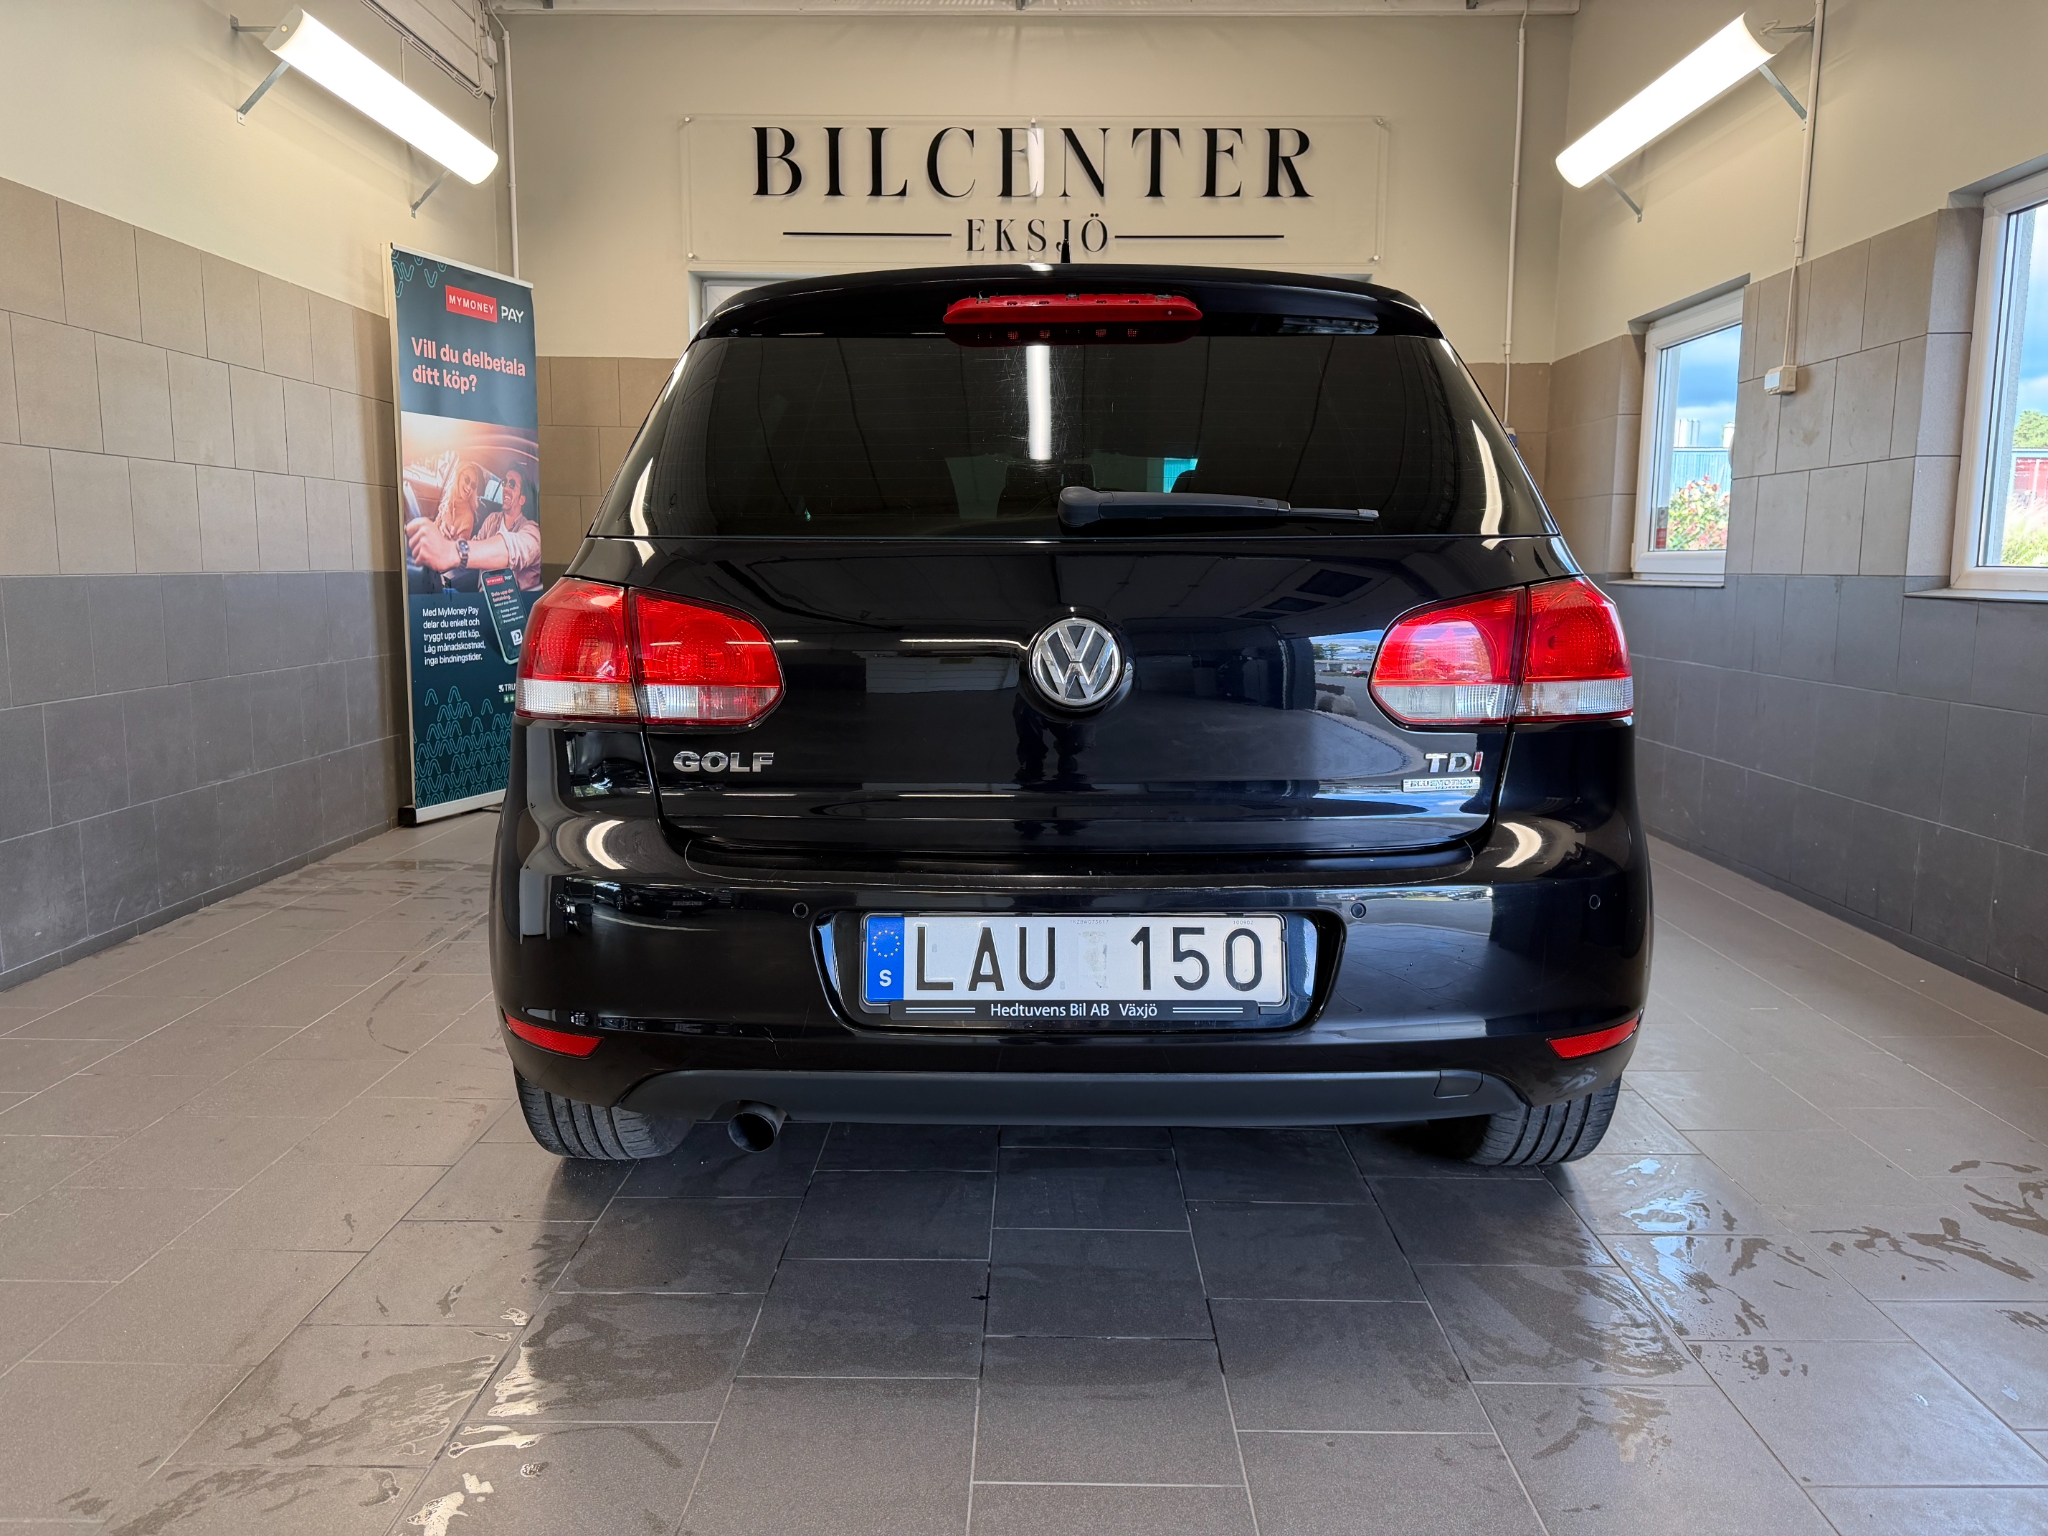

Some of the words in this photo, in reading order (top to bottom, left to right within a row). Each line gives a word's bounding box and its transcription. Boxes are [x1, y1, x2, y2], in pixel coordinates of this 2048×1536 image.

[751, 127, 1314, 198] BILCENTER
[966, 213, 1108, 252] EKSJÖ
[449, 295, 494, 314] MYMONEY
[501, 306, 524, 323] PAY
[411, 337, 436, 359] Vill
[440, 344, 459, 364] du
[462, 349, 526, 377] delbetala
[412, 365, 440, 386] ditt
[443, 370, 478, 394] köp?
[423, 608, 437, 617] Med
[438, 607, 467, 617] MyMoney
[468, 606, 479, 616] Pay
[423, 620, 439, 629] delar
[440, 619, 449, 628] du
[450, 618, 468, 627] enkelt
[469, 618, 480, 626] och
[424, 632, 443, 642] tryggt
[444, 632, 456, 641] upp
[457, 630, 467, 638] ditt
[468, 629, 480, 639] köp.
[424, 644, 436, 654] Låg
[437, 640, 486, 652] månadskostnad,
[424, 656, 438, 666] inga
[439, 653, 483, 664] bindningstider.
[504, 683, 516, 691] TRU
[673, 751, 774, 772] GOLF
[1425, 751, 1484, 773] TDI
[916, 926, 1056, 991] LAU
[1130, 926, 1263, 991] 150
[879, 969, 892, 987] S
[990, 1003, 1066, 1017] Hedtuvens
[1070, 1003, 1086, 1017] Bil
[1090, 1003, 1110, 1017] AB
[1119, 1003, 1158, 1019] Växjö
